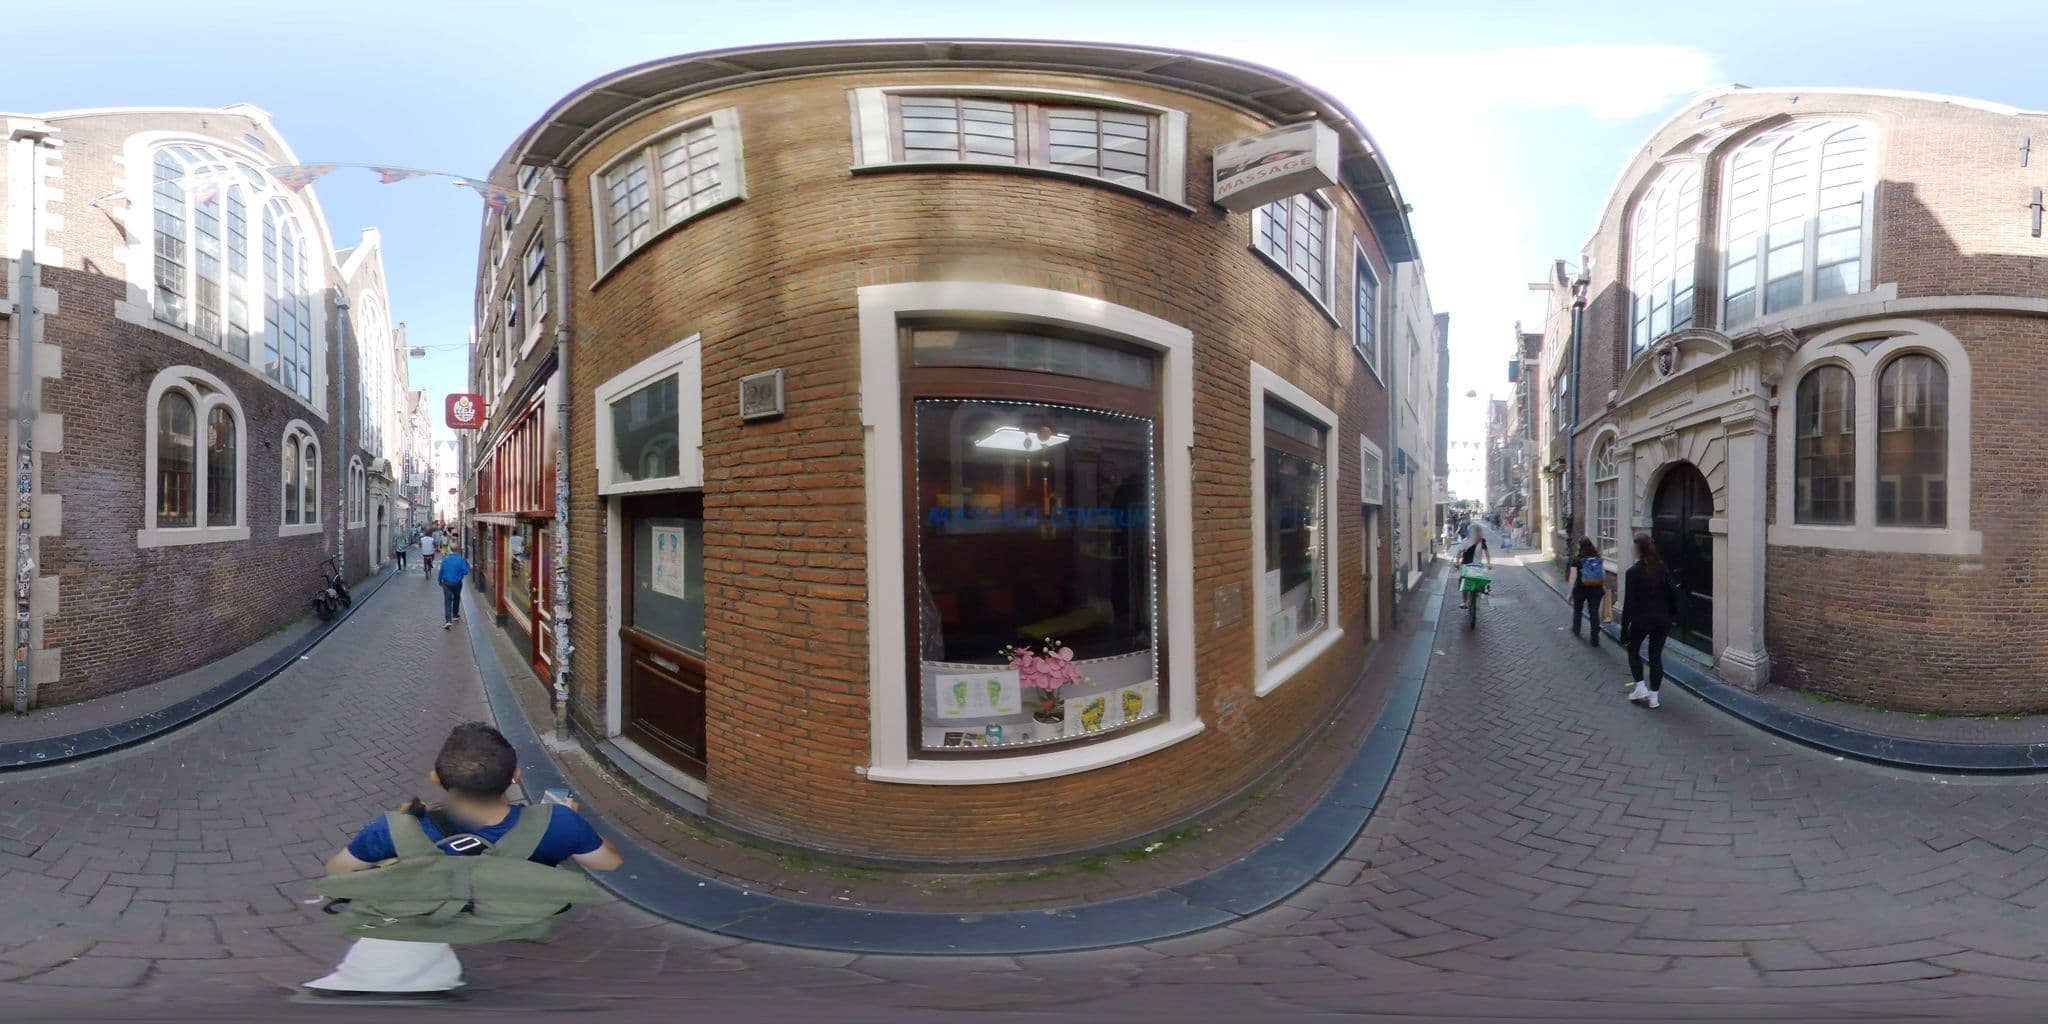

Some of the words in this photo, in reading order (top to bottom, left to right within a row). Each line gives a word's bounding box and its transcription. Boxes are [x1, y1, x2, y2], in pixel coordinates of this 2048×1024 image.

[1218, 158, 1311, 194] MASSAGE
[749, 383, 773, 404] 20
[1051, 506, 1150, 528] CENTRUM
